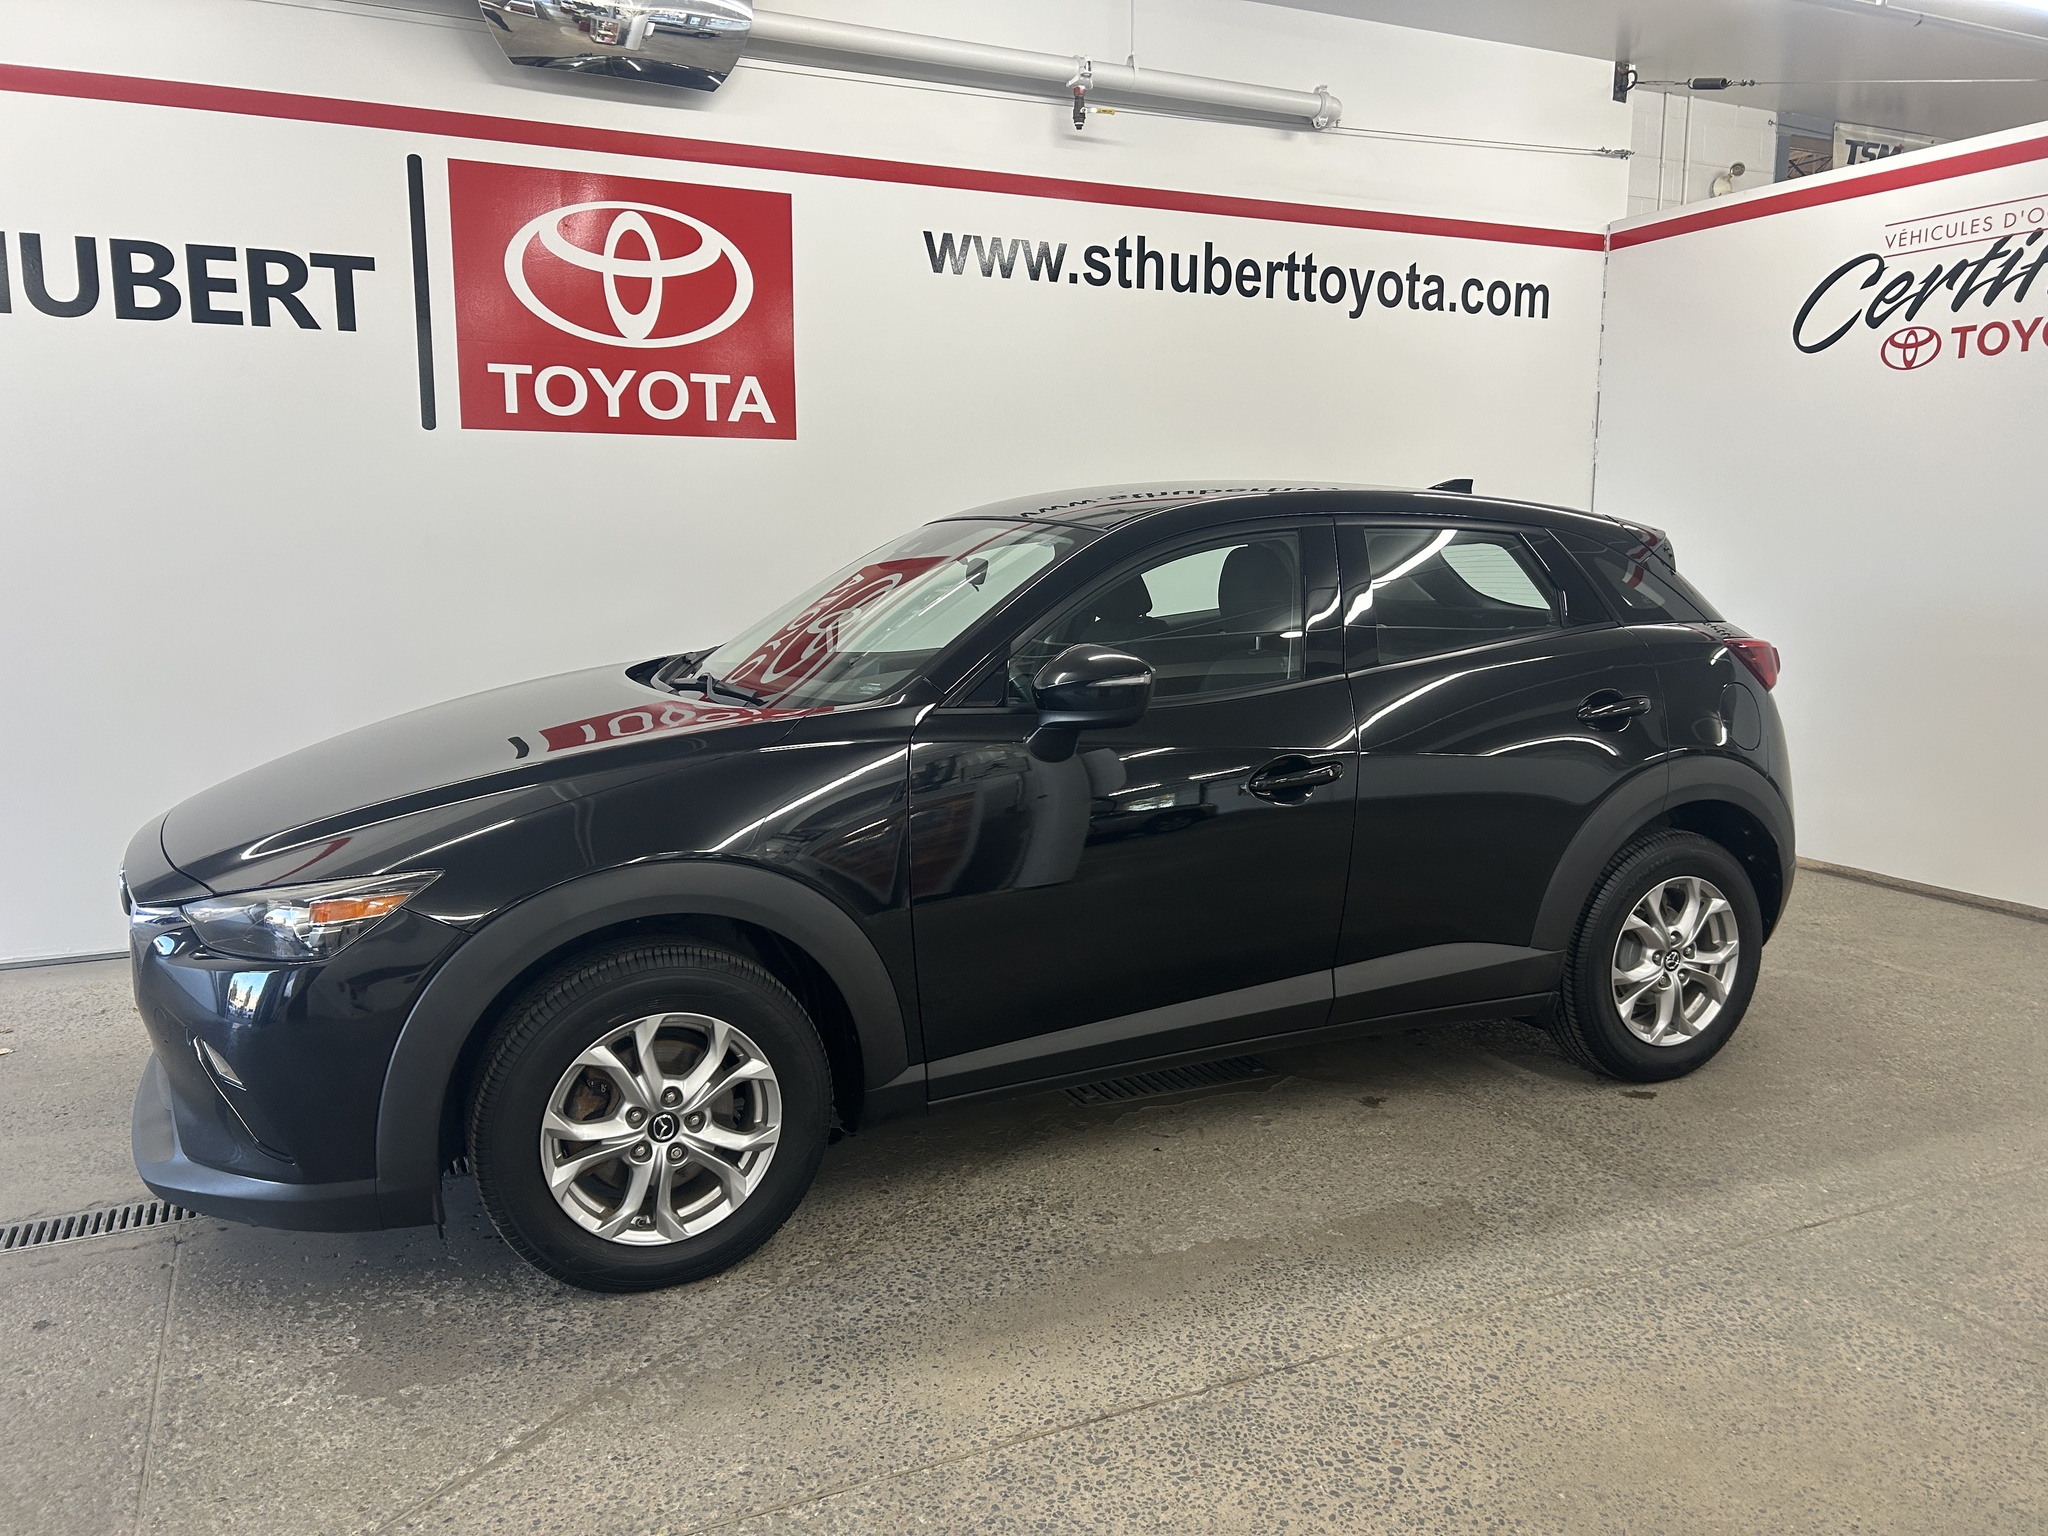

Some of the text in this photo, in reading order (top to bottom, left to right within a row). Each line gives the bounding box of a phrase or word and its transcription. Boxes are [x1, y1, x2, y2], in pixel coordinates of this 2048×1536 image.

[1885, 206, 2048, 249] VÉHICULES D'O
[922, 230, 1550, 319] www.sthuberttoyota.com
[1951, 316, 2048, 359] TOY
[487, 363, 776, 424] TOYOTA
